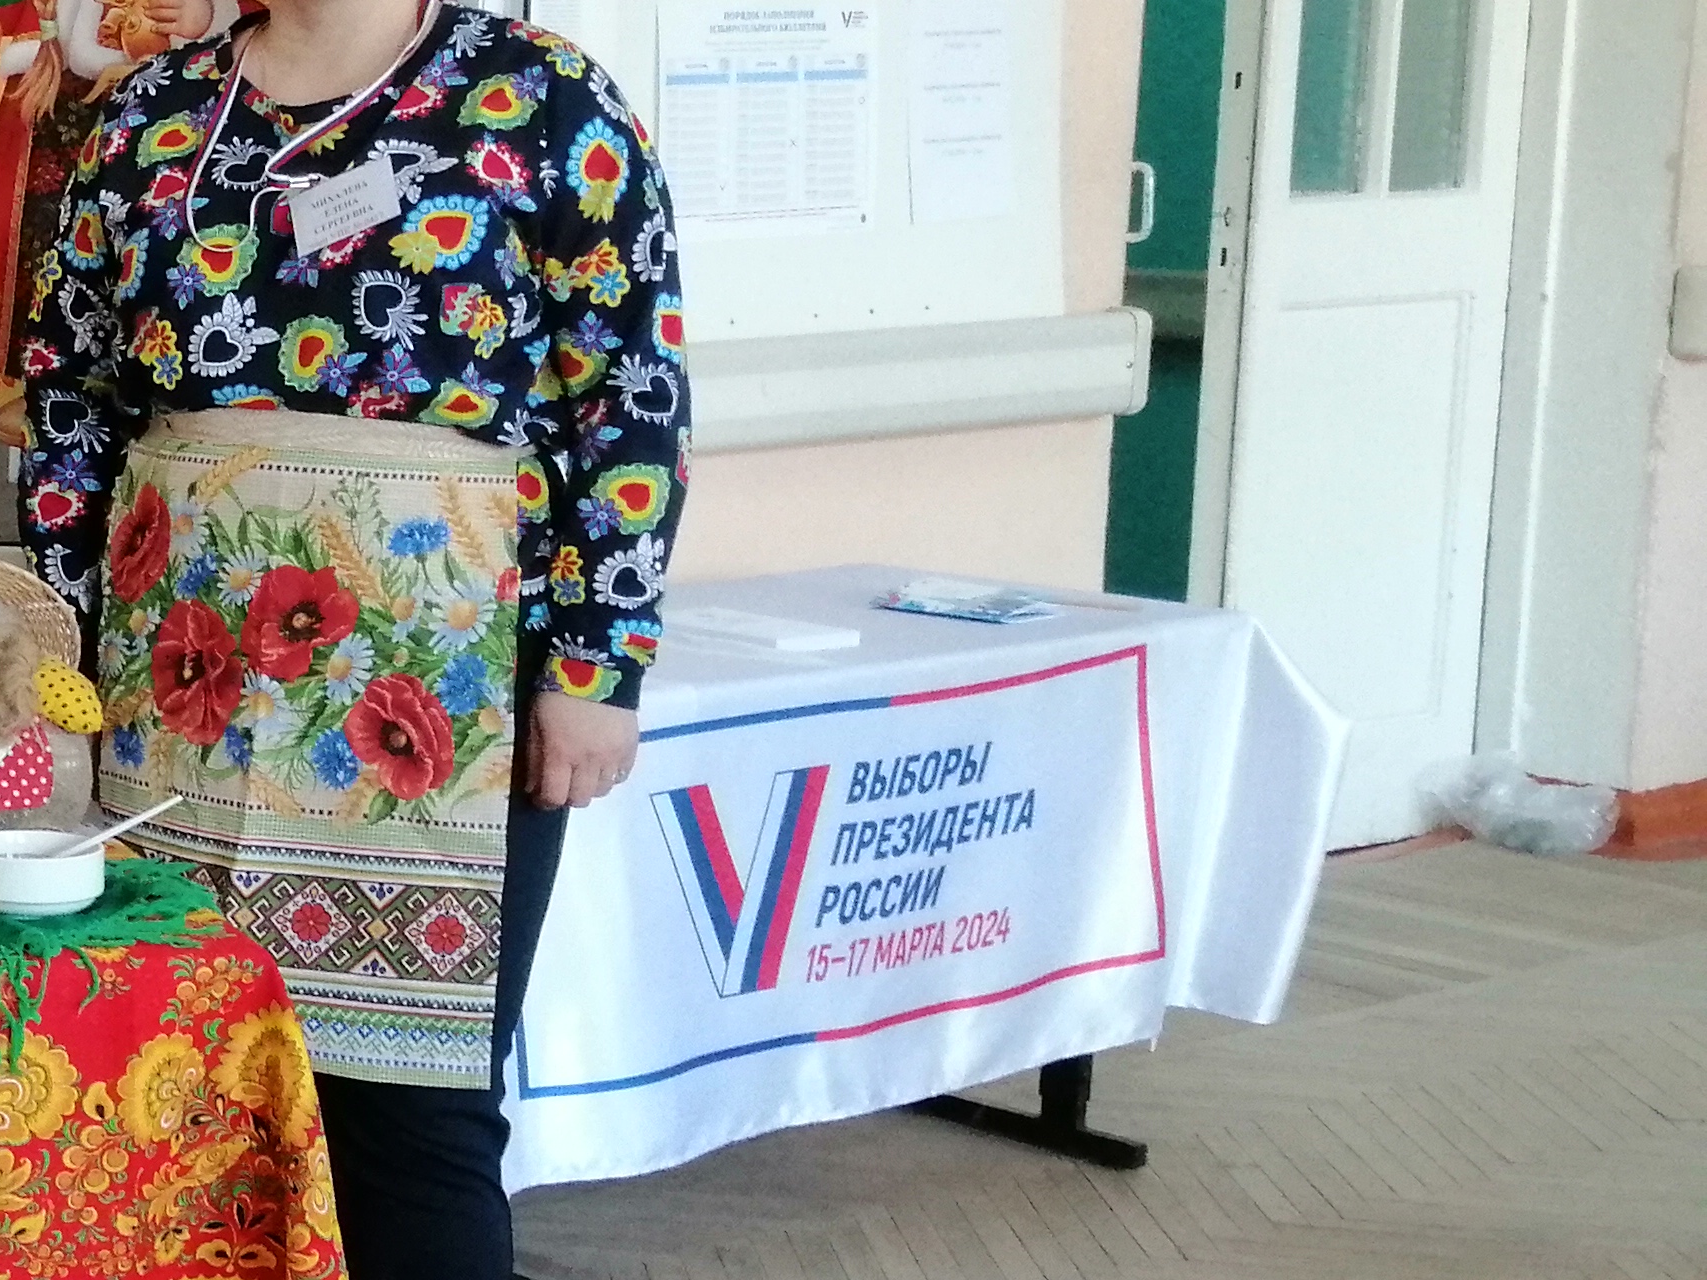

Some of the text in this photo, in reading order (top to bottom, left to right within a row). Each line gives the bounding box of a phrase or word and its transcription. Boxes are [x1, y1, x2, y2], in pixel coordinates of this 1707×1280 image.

[845, 741, 993, 805] ВЫБОРЫ
[830, 789, 1036, 866] ПРЕЗИДЕНТА
[815, 865, 946, 927] РОССИИ
[874, 921, 945, 974] МАРТА
[950, 906, 1011, 953] 2024
